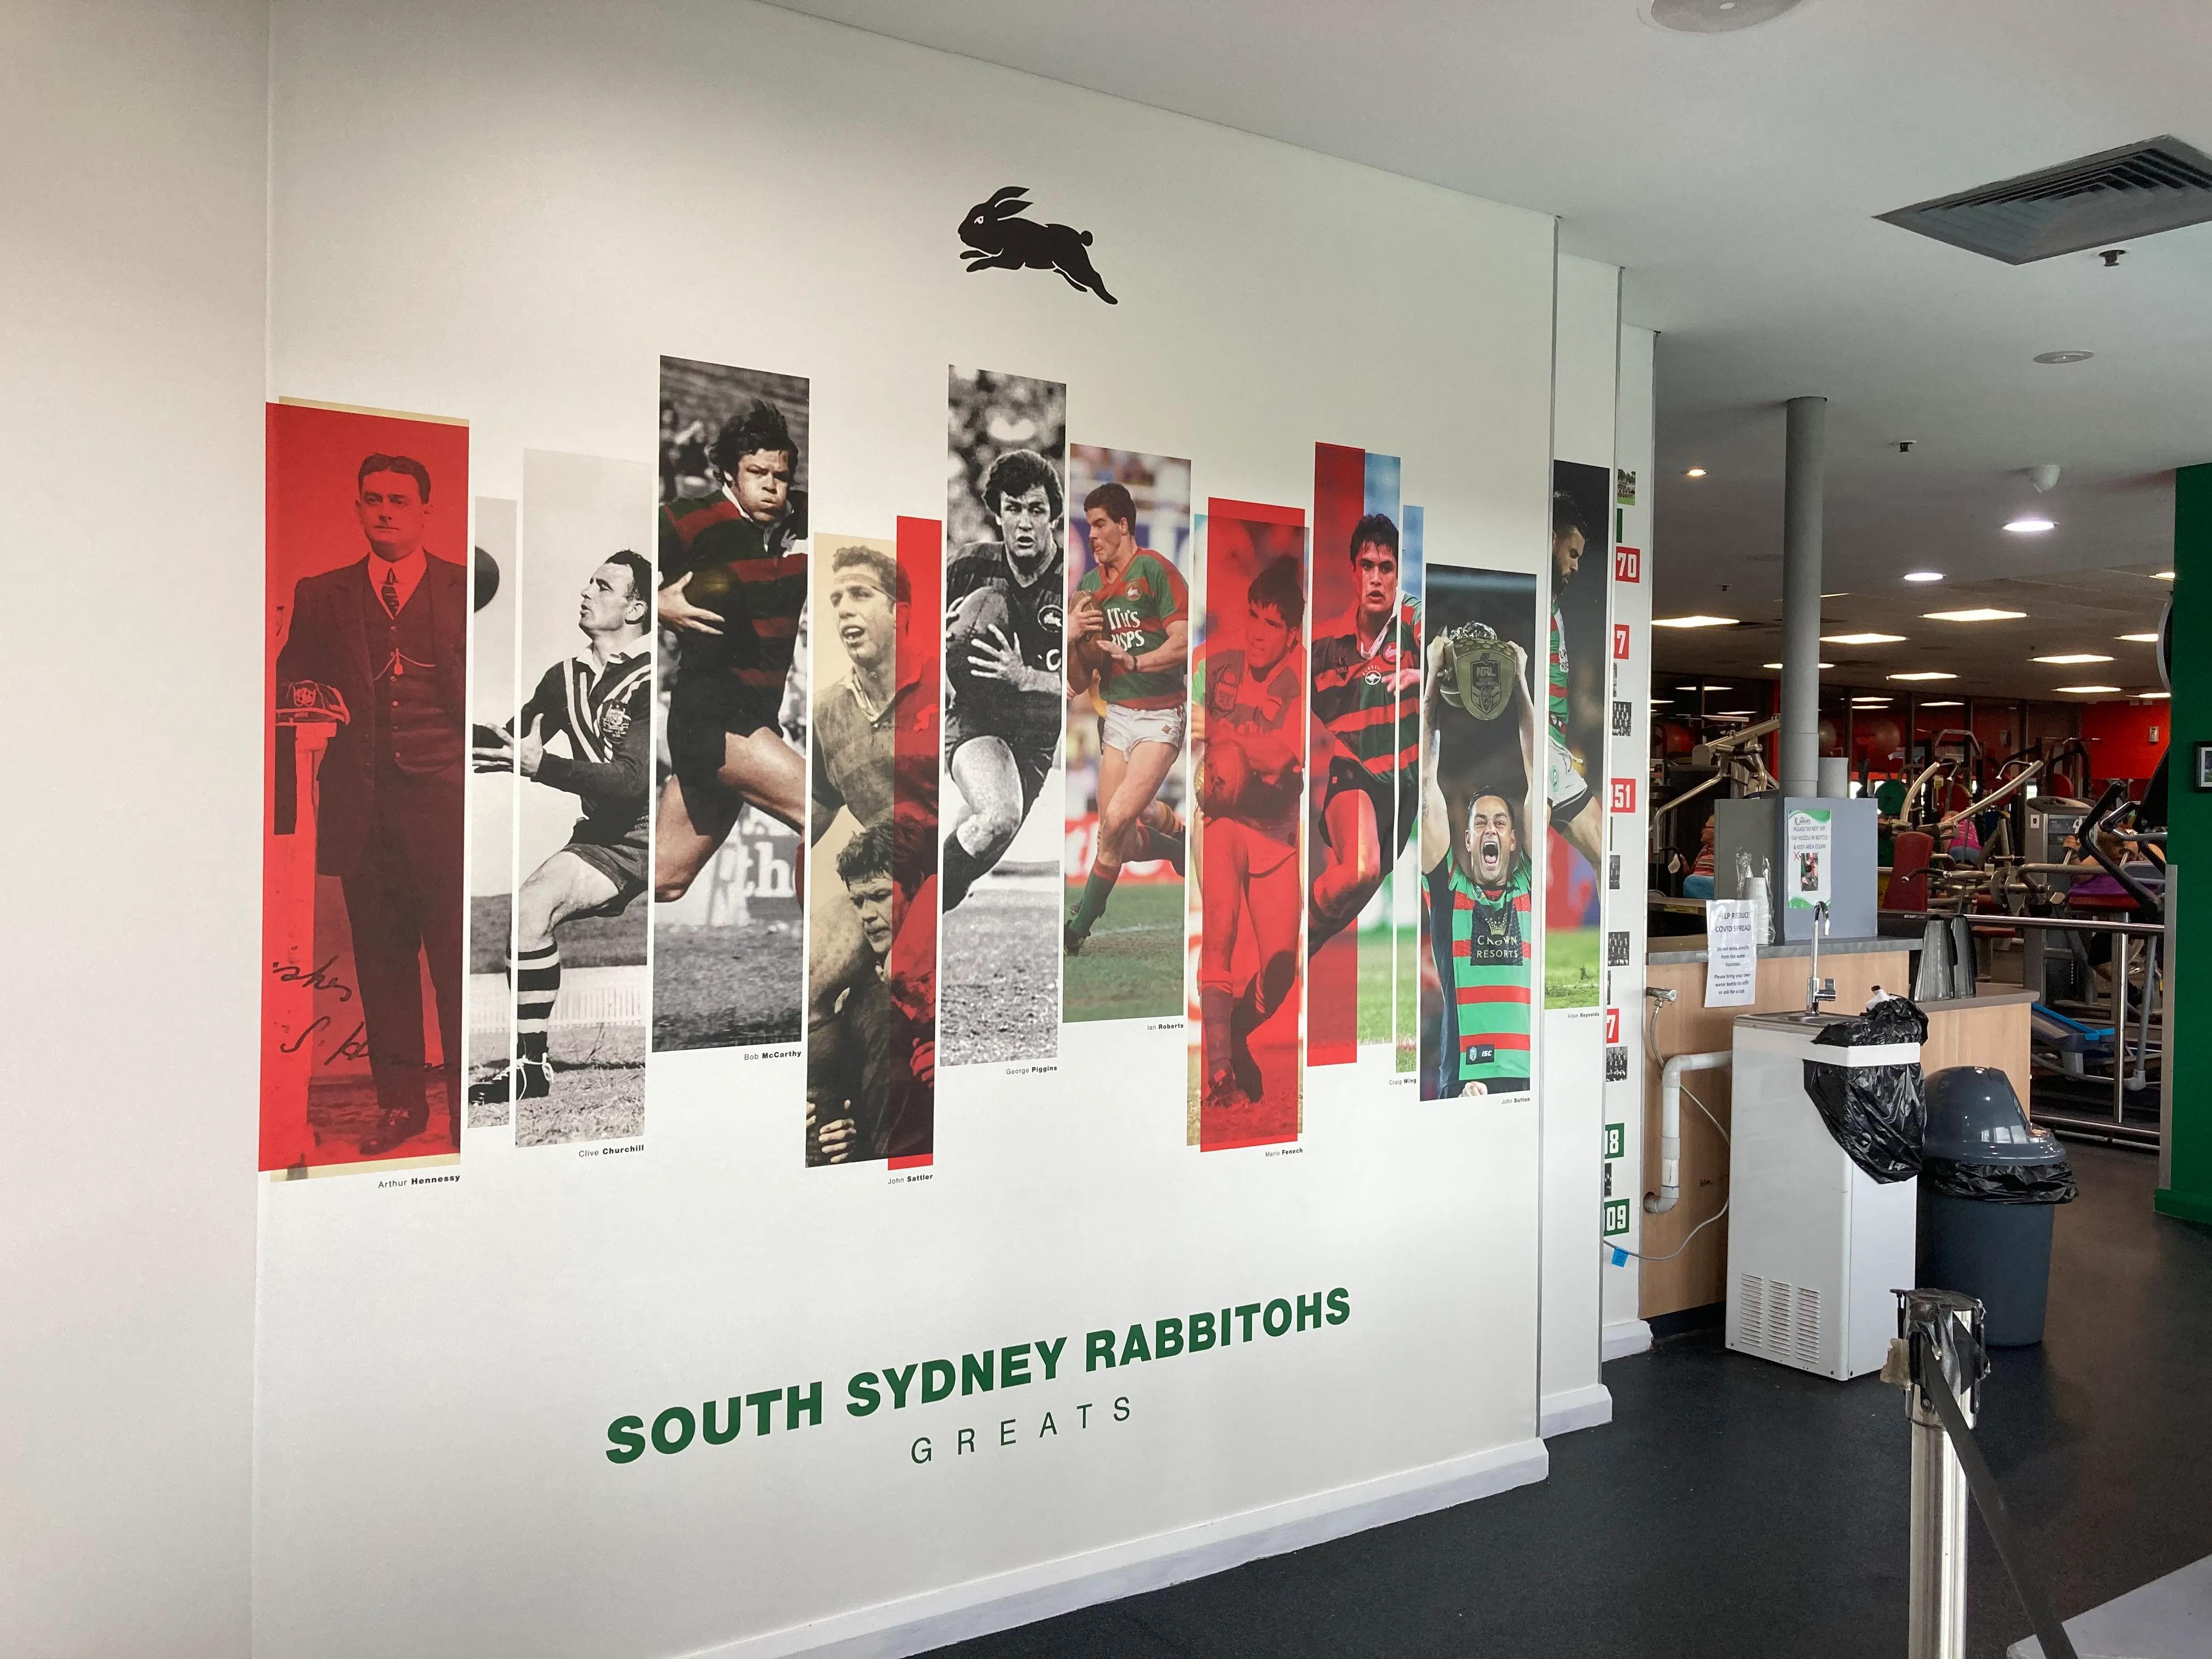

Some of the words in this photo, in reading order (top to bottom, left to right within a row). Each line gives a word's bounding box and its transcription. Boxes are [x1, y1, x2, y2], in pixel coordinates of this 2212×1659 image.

[1476, 666, 1496, 677] NRL
[1477, 950, 1518, 958] RESORTS
[762, 1051, 802, 1059] McCarthy
[602, 1144, 644, 1155] Churchill
[378, 1180, 408, 1189] Arthur
[411, 1175, 460, 1185] Hennessy
[907, 1174, 933, 1182] Sattler
[606, 1382, 823, 1464] SOUTH
[848, 1337, 1066, 1417] SYDNEY
[1086, 1288, 1350, 1372] RABBITOHS
[911, 1396, 1131, 1465] GREATS
